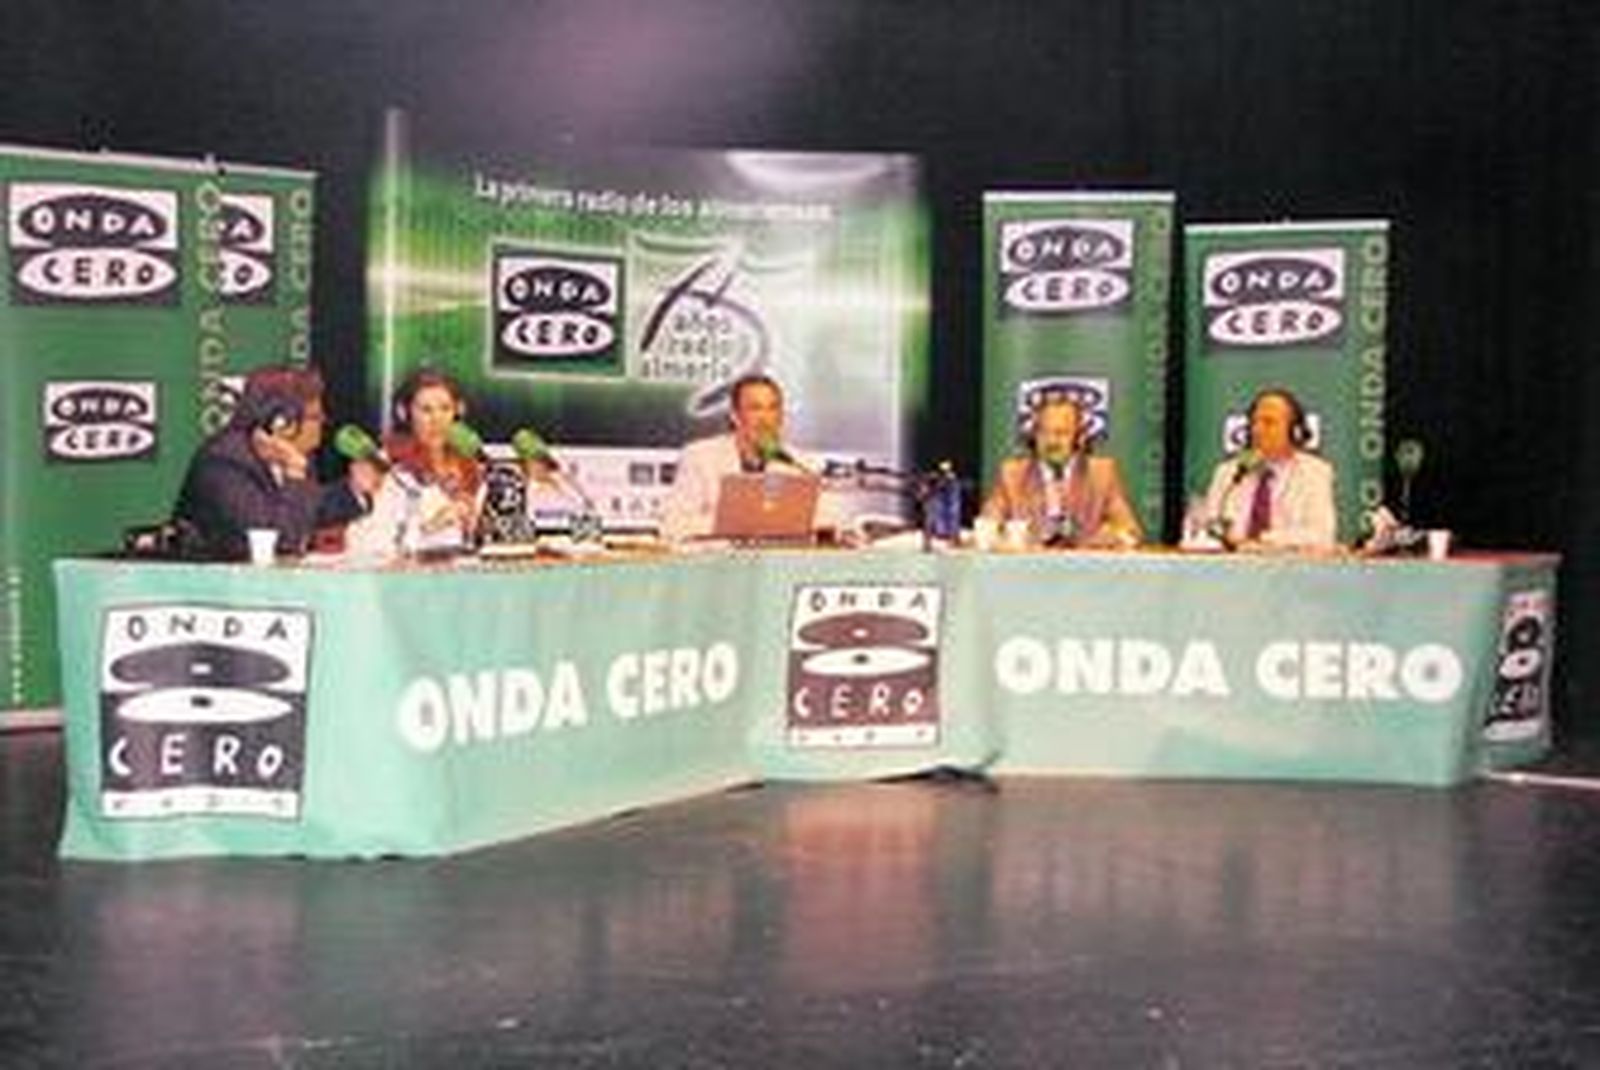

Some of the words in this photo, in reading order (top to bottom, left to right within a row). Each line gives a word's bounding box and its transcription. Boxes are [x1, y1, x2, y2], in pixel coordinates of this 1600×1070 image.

[475, 172, 497, 197] La
[502, 181, 573, 210] primera
[578, 188, 627, 214] radio
[630, 189, 657, 214] de
[660, 192, 693, 217] los
[33, 207, 156, 237] ONDA
[197, 182, 224, 293] CERO
[1015, 233, 1118, 260] ONDA
[43, 256, 156, 287] CERO
[1219, 268, 1327, 295] ONDA
[1360, 234, 1388, 333] CERO
[511, 278, 602, 302] ONDA
[1021, 275, 1115, 302] CERO
[516, 320, 600, 346] CERO
[1226, 310, 1325, 336] CERO
[199, 304, 230, 436] ONDA
[58, 398, 141, 416] ONDA
[1359, 343, 1385, 460] ONDA
[65, 430, 142, 450] CERO
[810, 590, 928, 612] ONDA
[127, 614, 289, 641] ONDA
[994, 635, 1231, 698] ONDA
[1255, 640, 1465, 703] CERO
[399, 660, 588, 752] ONDA
[607, 641, 739, 720] CERO
[794, 682, 925, 719] CERO
[108, 733, 284, 779] CERO
